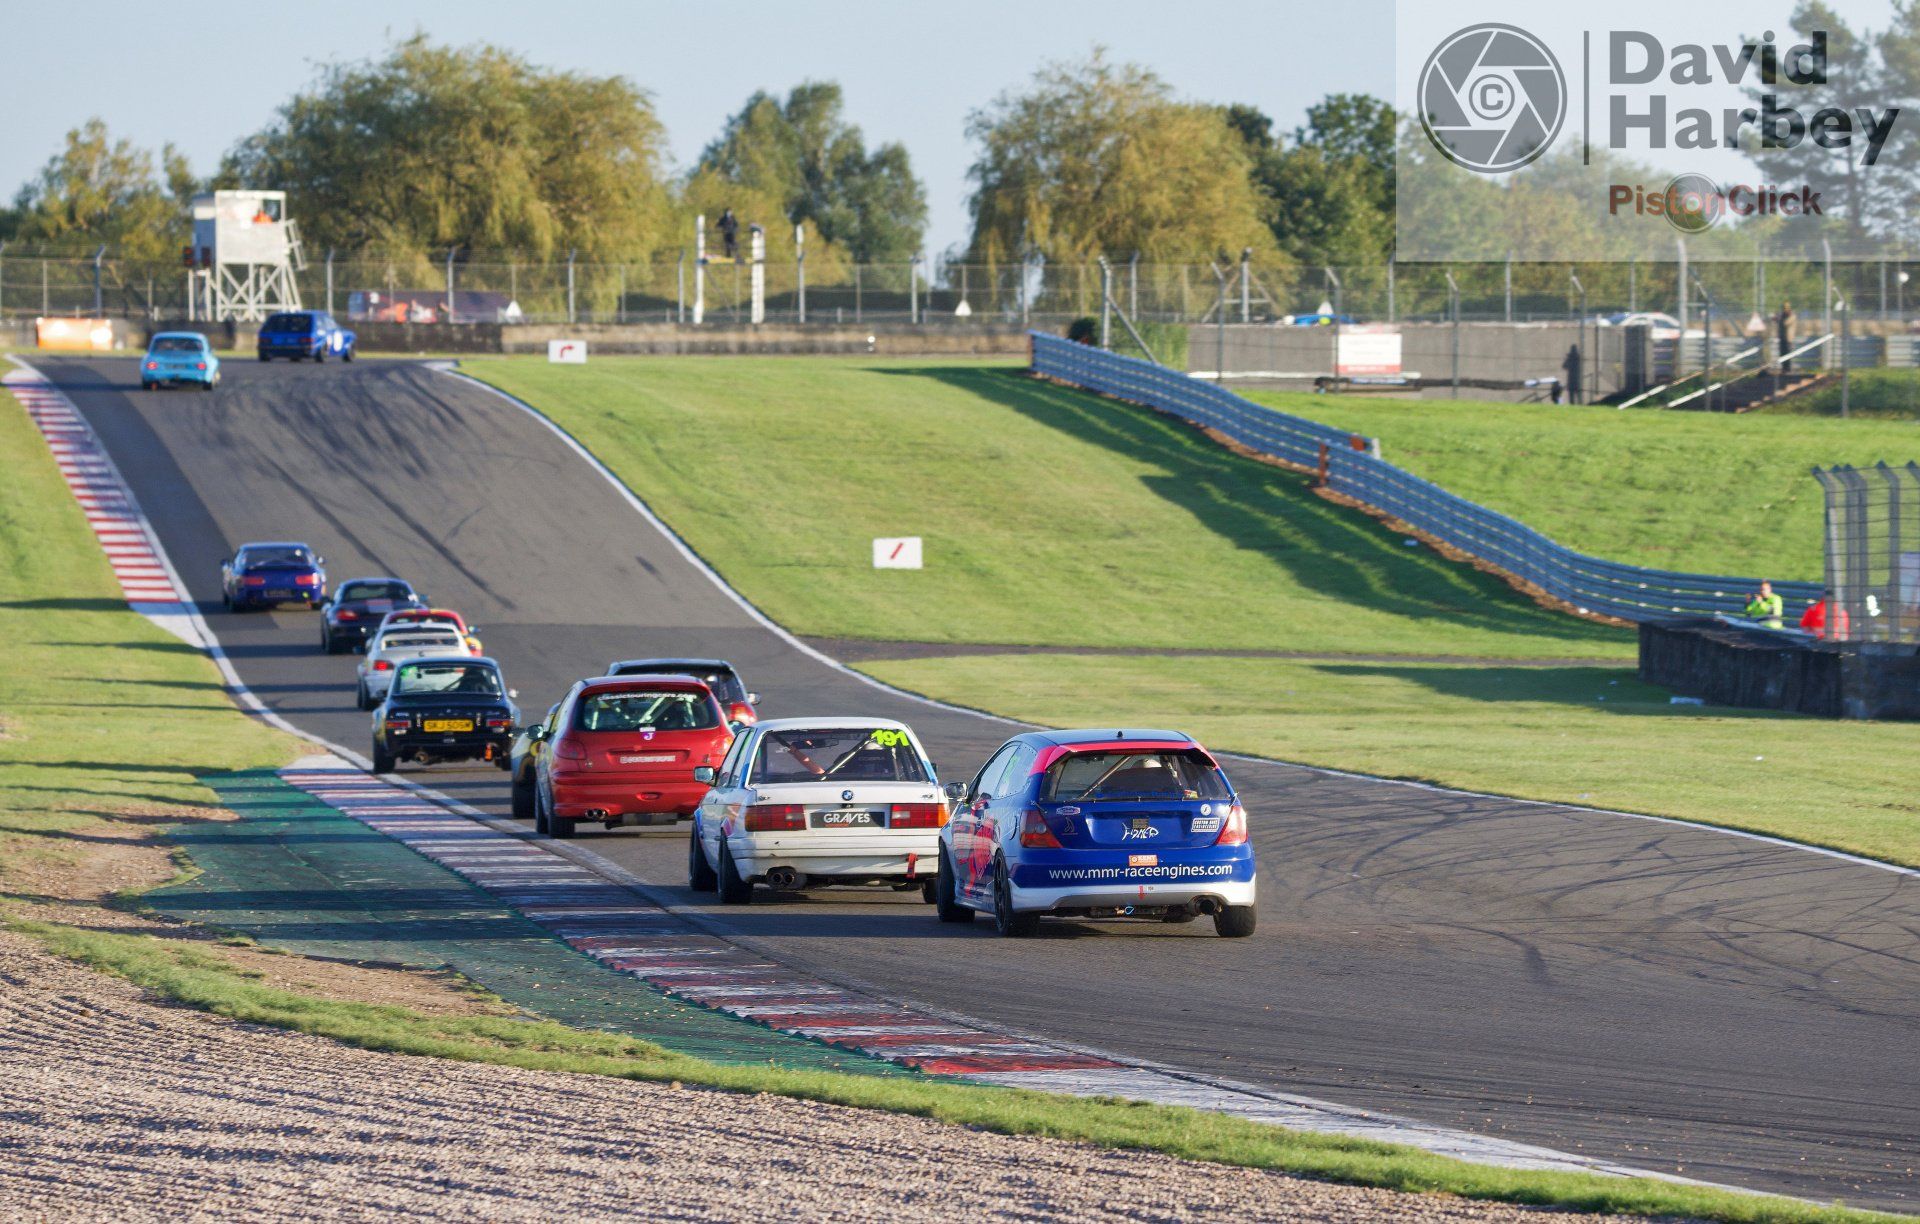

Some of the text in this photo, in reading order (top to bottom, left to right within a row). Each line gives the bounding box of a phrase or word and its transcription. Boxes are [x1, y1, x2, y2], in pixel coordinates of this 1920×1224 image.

[871, 730, 910, 746] 191
[823, 812, 870, 824] GRAVES
[1049, 863, 1233, 879] www.mmr-raceengines.com
